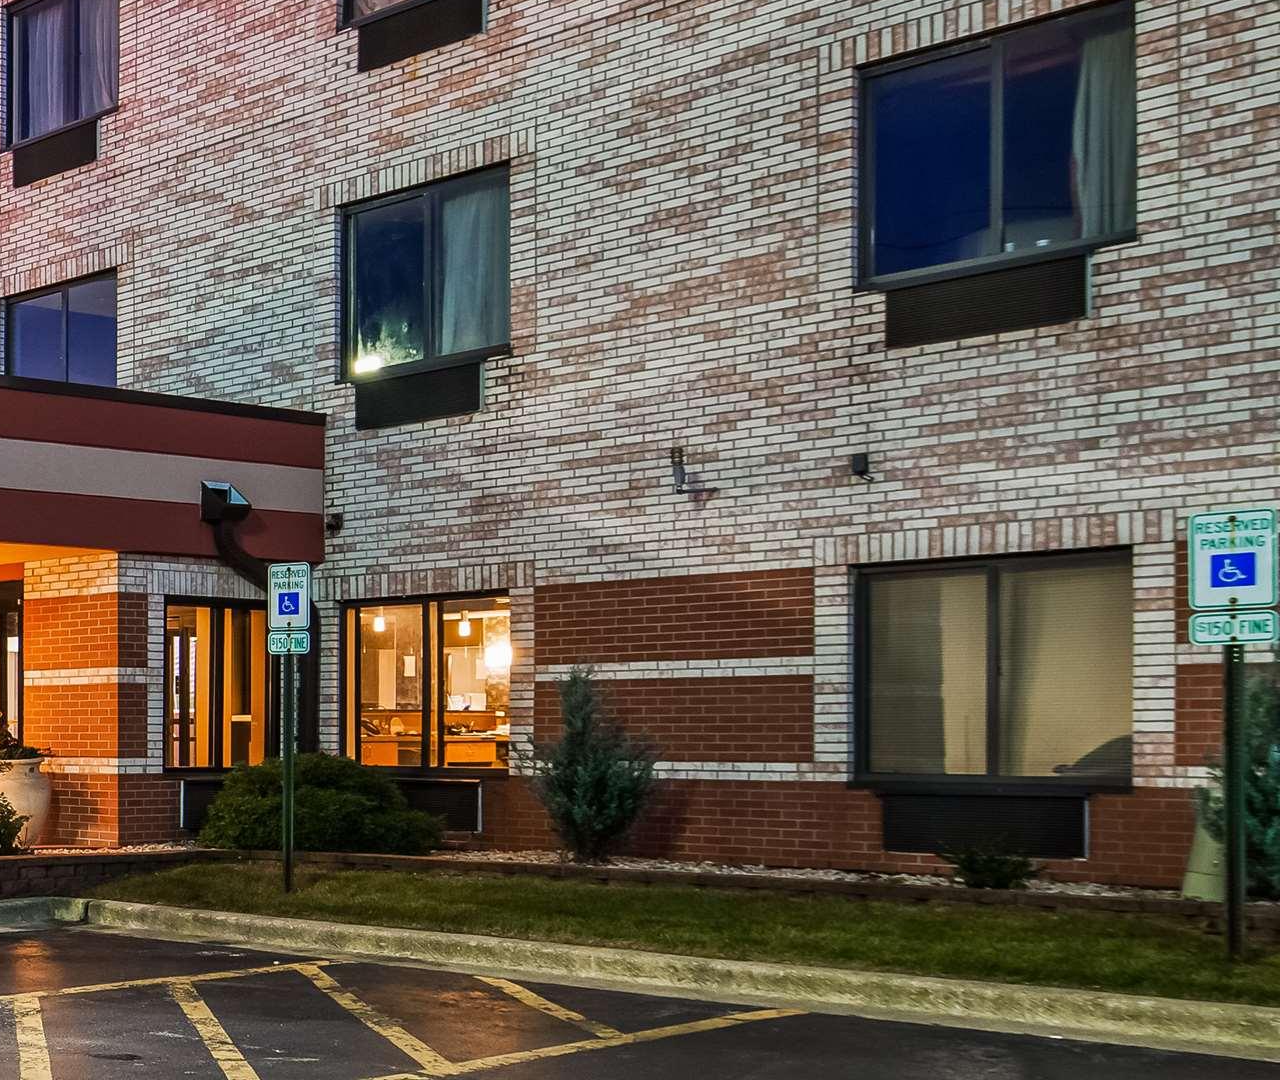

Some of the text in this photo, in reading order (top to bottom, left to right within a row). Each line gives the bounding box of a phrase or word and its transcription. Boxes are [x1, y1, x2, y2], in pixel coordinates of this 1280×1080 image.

[1195, 518, 1270, 535] RESERVED
[1200, 535, 1266, 550] PARKING
[271, 569, 307, 579] RESERVED
[273, 581, 304, 590] PARKING
[1195, 619, 1272, 637] $150 FINE
[271, 636, 306, 650] $150 FINE
